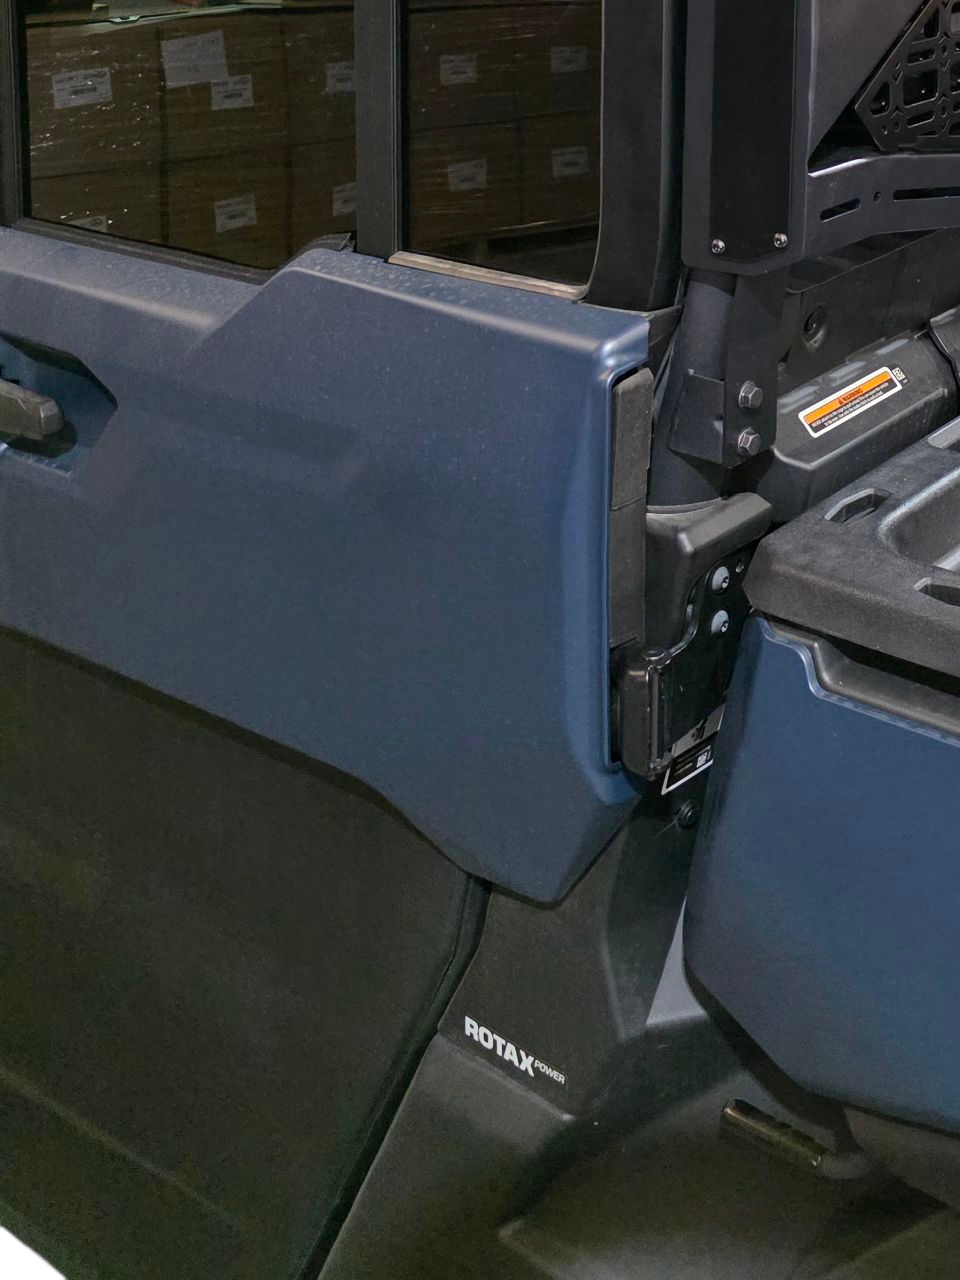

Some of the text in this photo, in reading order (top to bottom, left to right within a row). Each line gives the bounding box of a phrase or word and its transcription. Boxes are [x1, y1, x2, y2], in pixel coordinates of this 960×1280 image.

[842, 387, 864, 403] WARNING
[464, 1015, 566, 1085] ROTAX POWER
